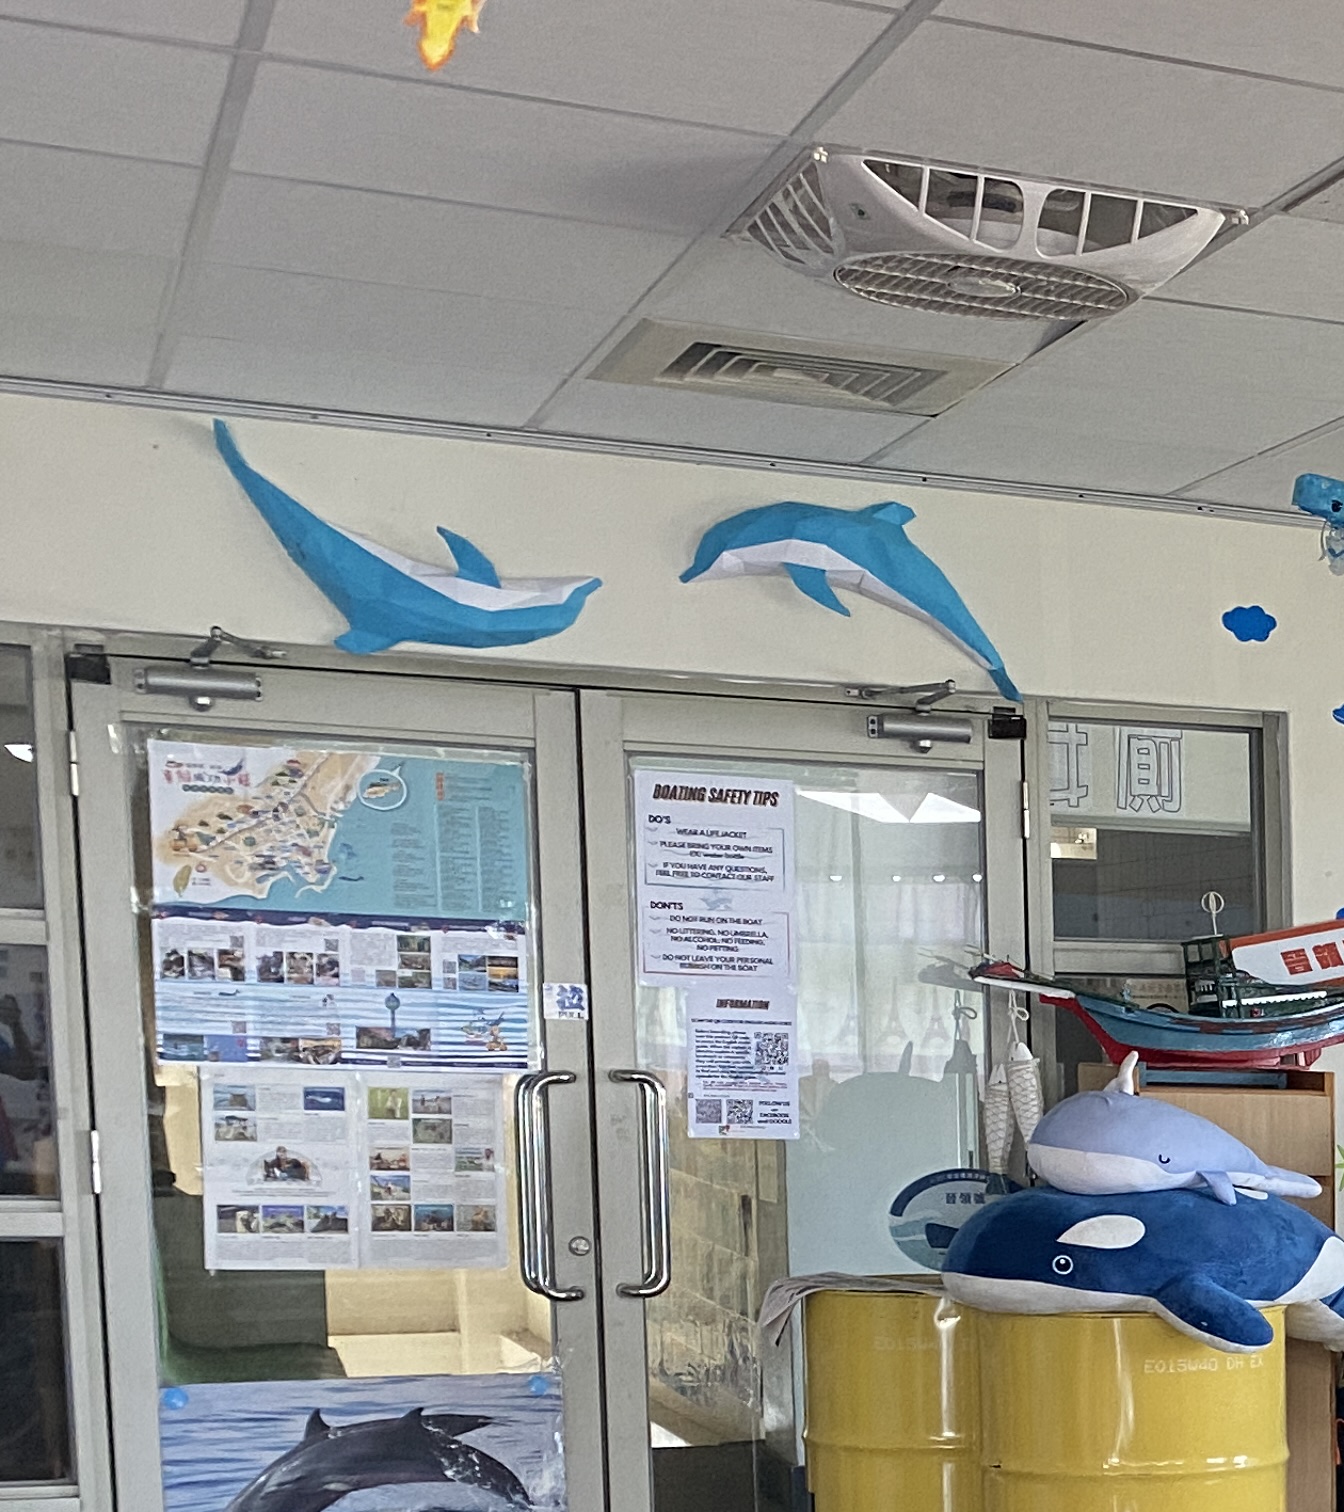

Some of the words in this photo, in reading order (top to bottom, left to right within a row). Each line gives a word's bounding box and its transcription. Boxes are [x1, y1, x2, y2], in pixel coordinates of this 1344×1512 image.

[653, 784, 706, 802] BOATING
[708, 787, 751, 805] SAFETY
[753, 790, 779, 807] TIPS
[648, 815, 671, 824] DO'S
[676, 828, 698, 836] WEAR
[720, 831, 747, 839] JACKET
[701, 872, 735, 880] CONTACT
